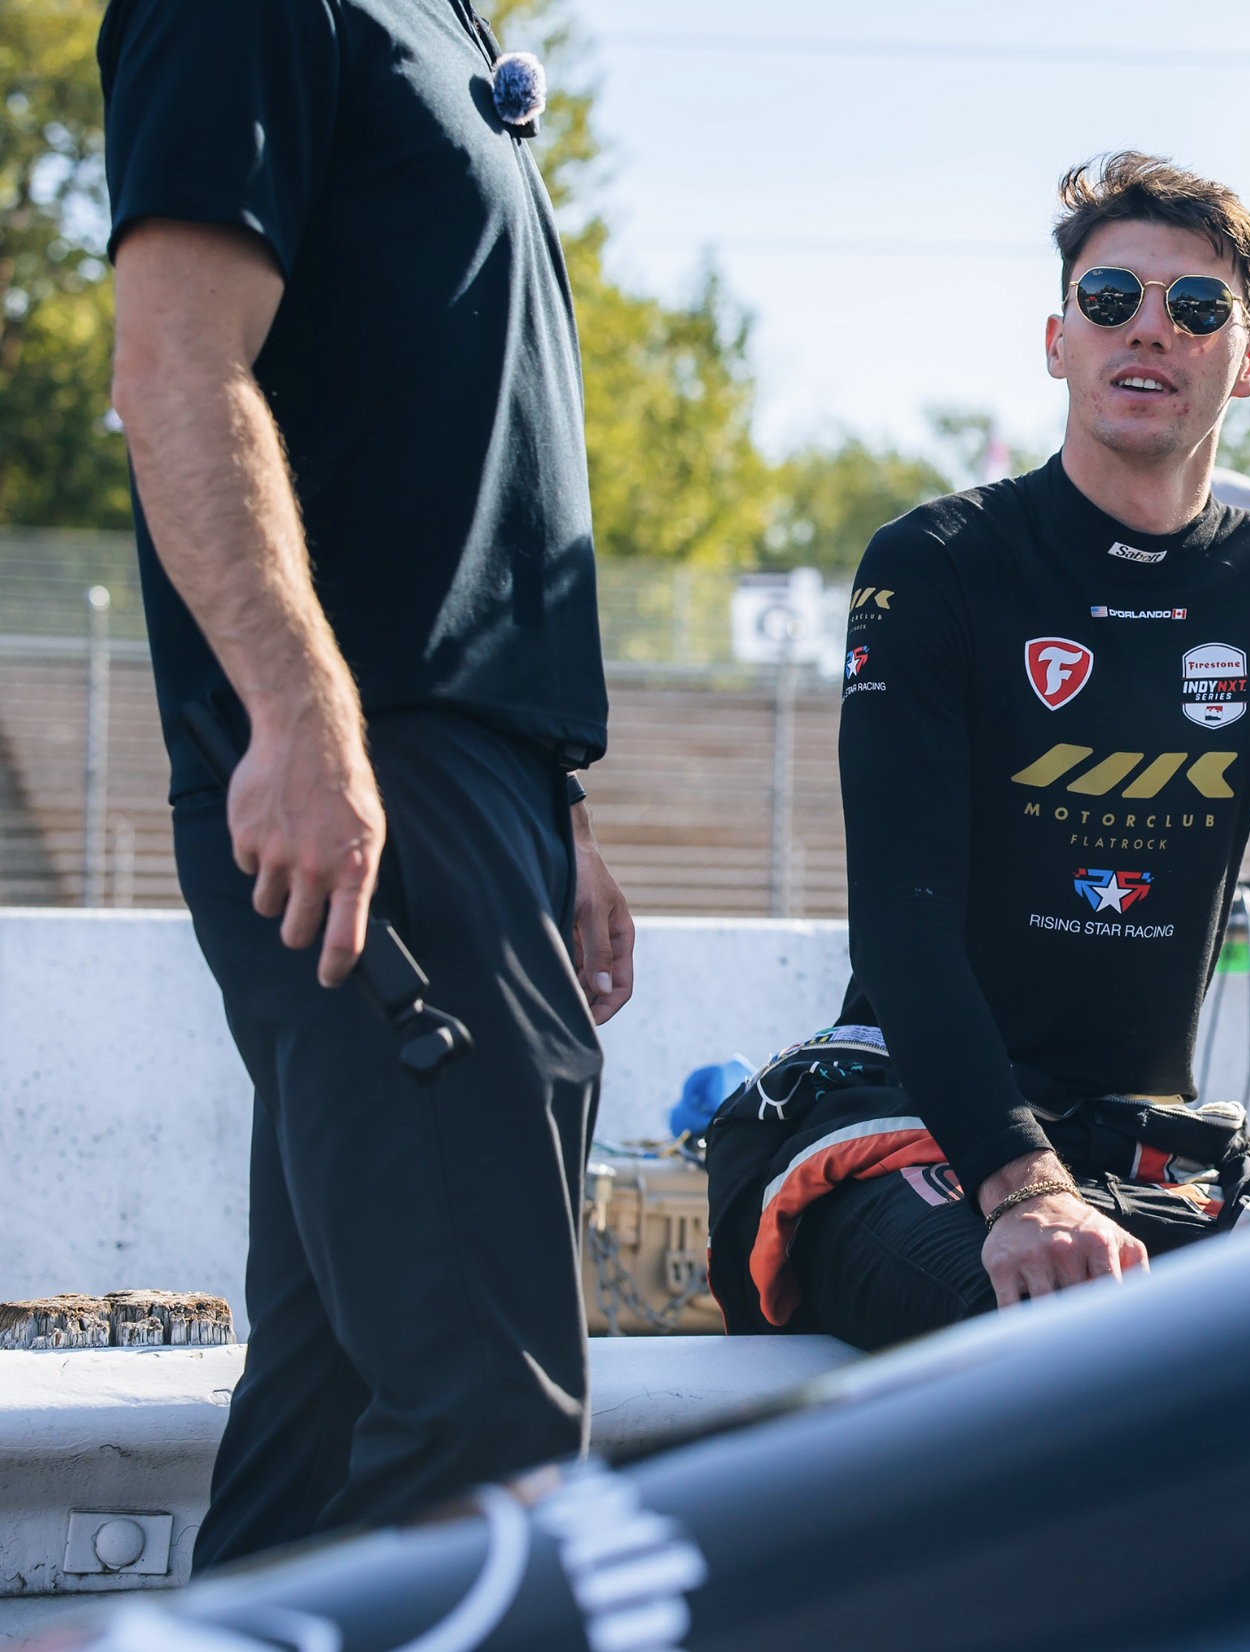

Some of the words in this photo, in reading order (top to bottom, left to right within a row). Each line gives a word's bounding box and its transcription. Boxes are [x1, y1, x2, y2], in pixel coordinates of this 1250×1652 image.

[1115, 545, 1161, 563] Sabelt
[1108, 608, 1172, 619] D'ORLANDO
[1188, 660, 1241, 670] Firestone
[857, 681, 886, 691] RACING
[1195, 692, 1232, 701] SERIES
[1023, 802, 1216, 828] MOTORCLUB
[1070, 834, 1168, 850] FLATROCK
[1029, 914, 1081, 933] RISING
[1084, 921, 1122, 937] STAR
[1124, 924, 1175, 938] RACING
